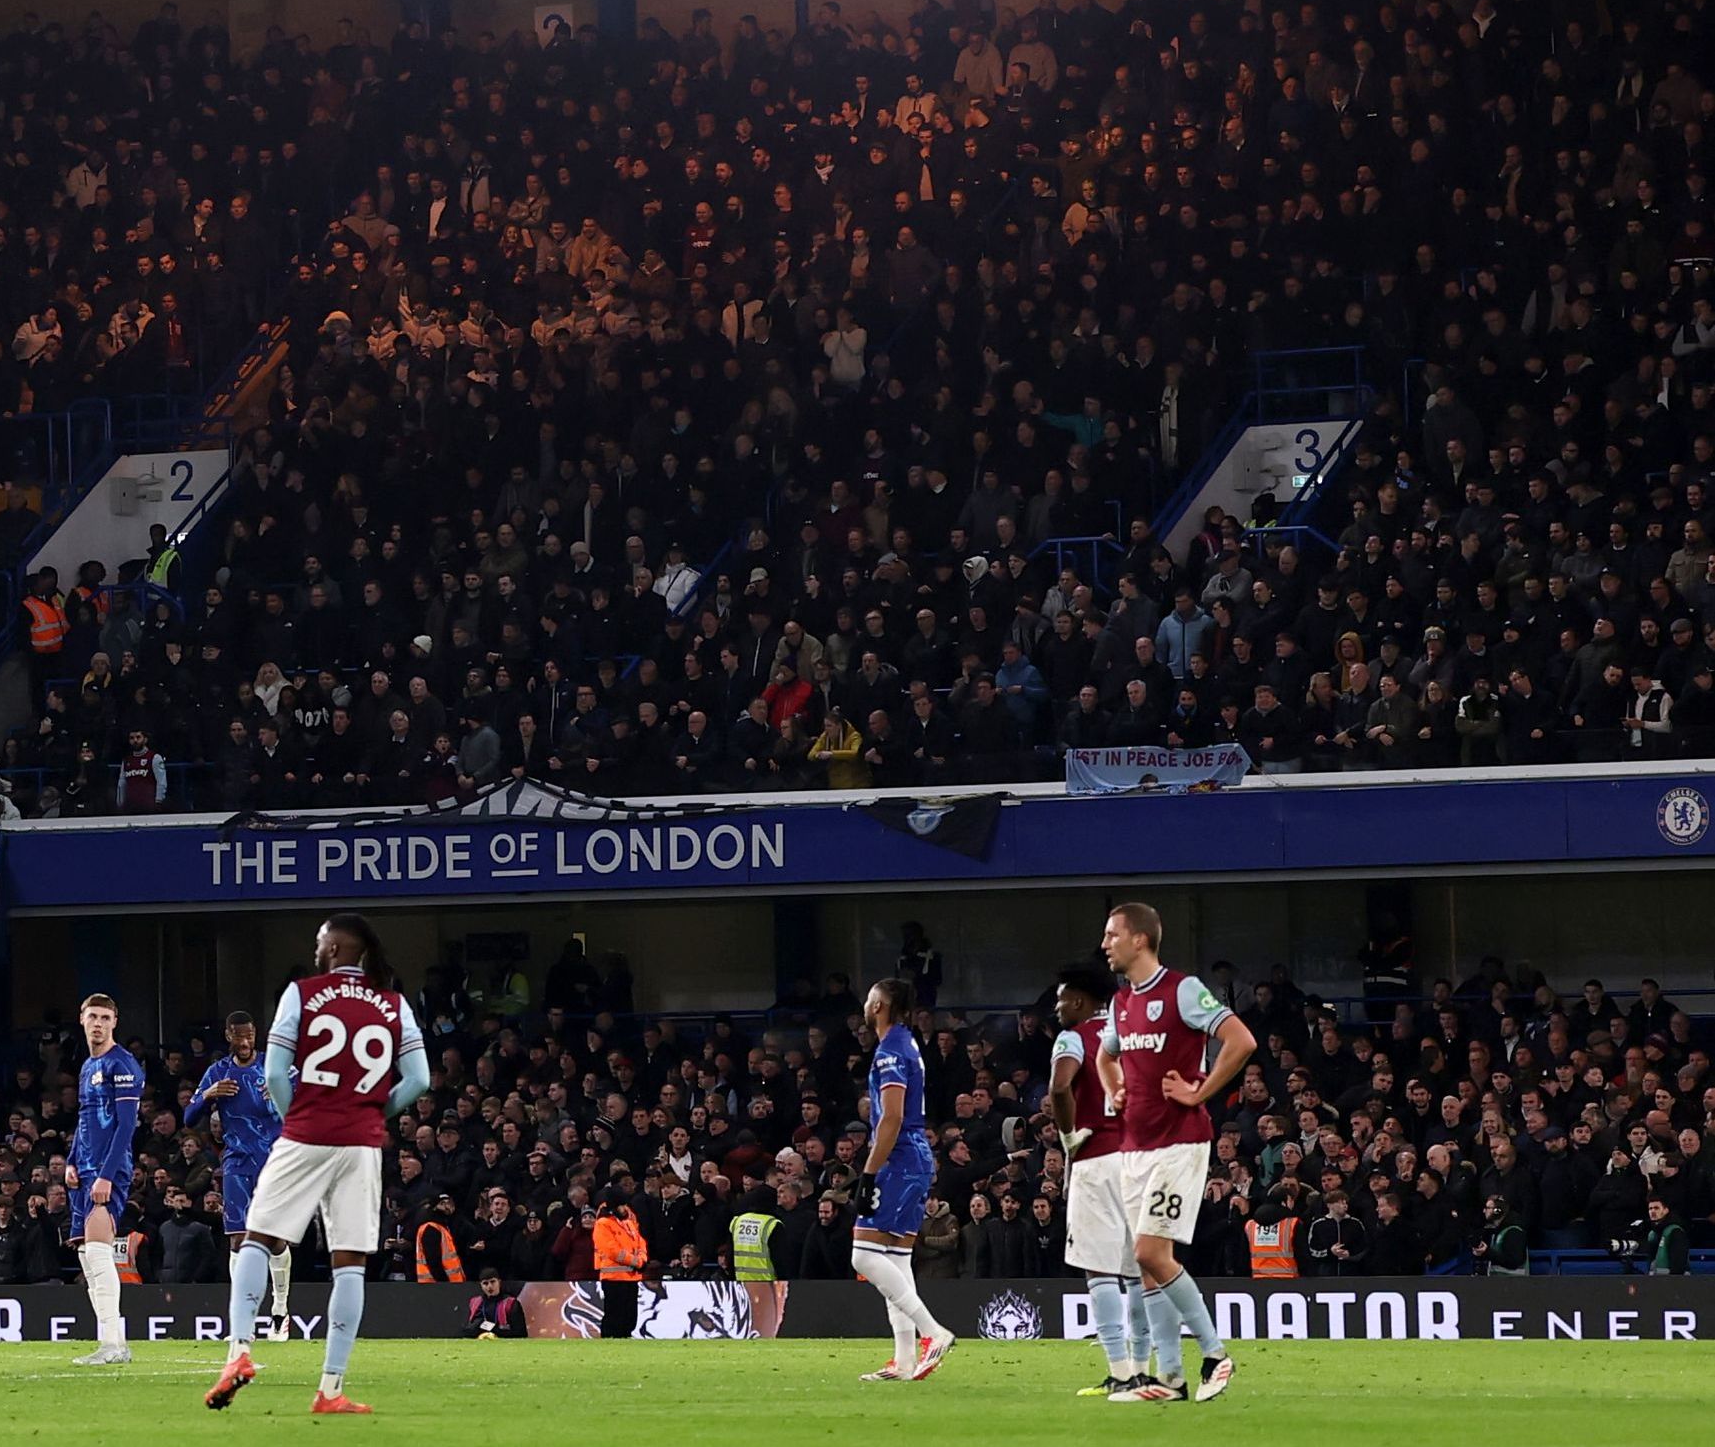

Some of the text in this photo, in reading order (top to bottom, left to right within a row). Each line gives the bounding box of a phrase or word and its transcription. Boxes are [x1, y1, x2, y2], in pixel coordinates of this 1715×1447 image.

[1295, 429, 1321, 473] 3
[170, 460, 193, 501] 2
[1106, 751, 1121, 766] IN
[1127, 752, 1178, 767] PEACE
[1183, 752, 1213, 767] JOE
[202, 823, 785, 885] THE PRIDE OF LONDON
[304, 984, 398, 1023] WAN-BISSAKA
[301, 1014, 393, 1094] 29
[1149, 1190, 1183, 1220] 28
[739, 1224, 759, 1236] 263
[1063, 1292, 1697, 1340] PDATOR ENER
